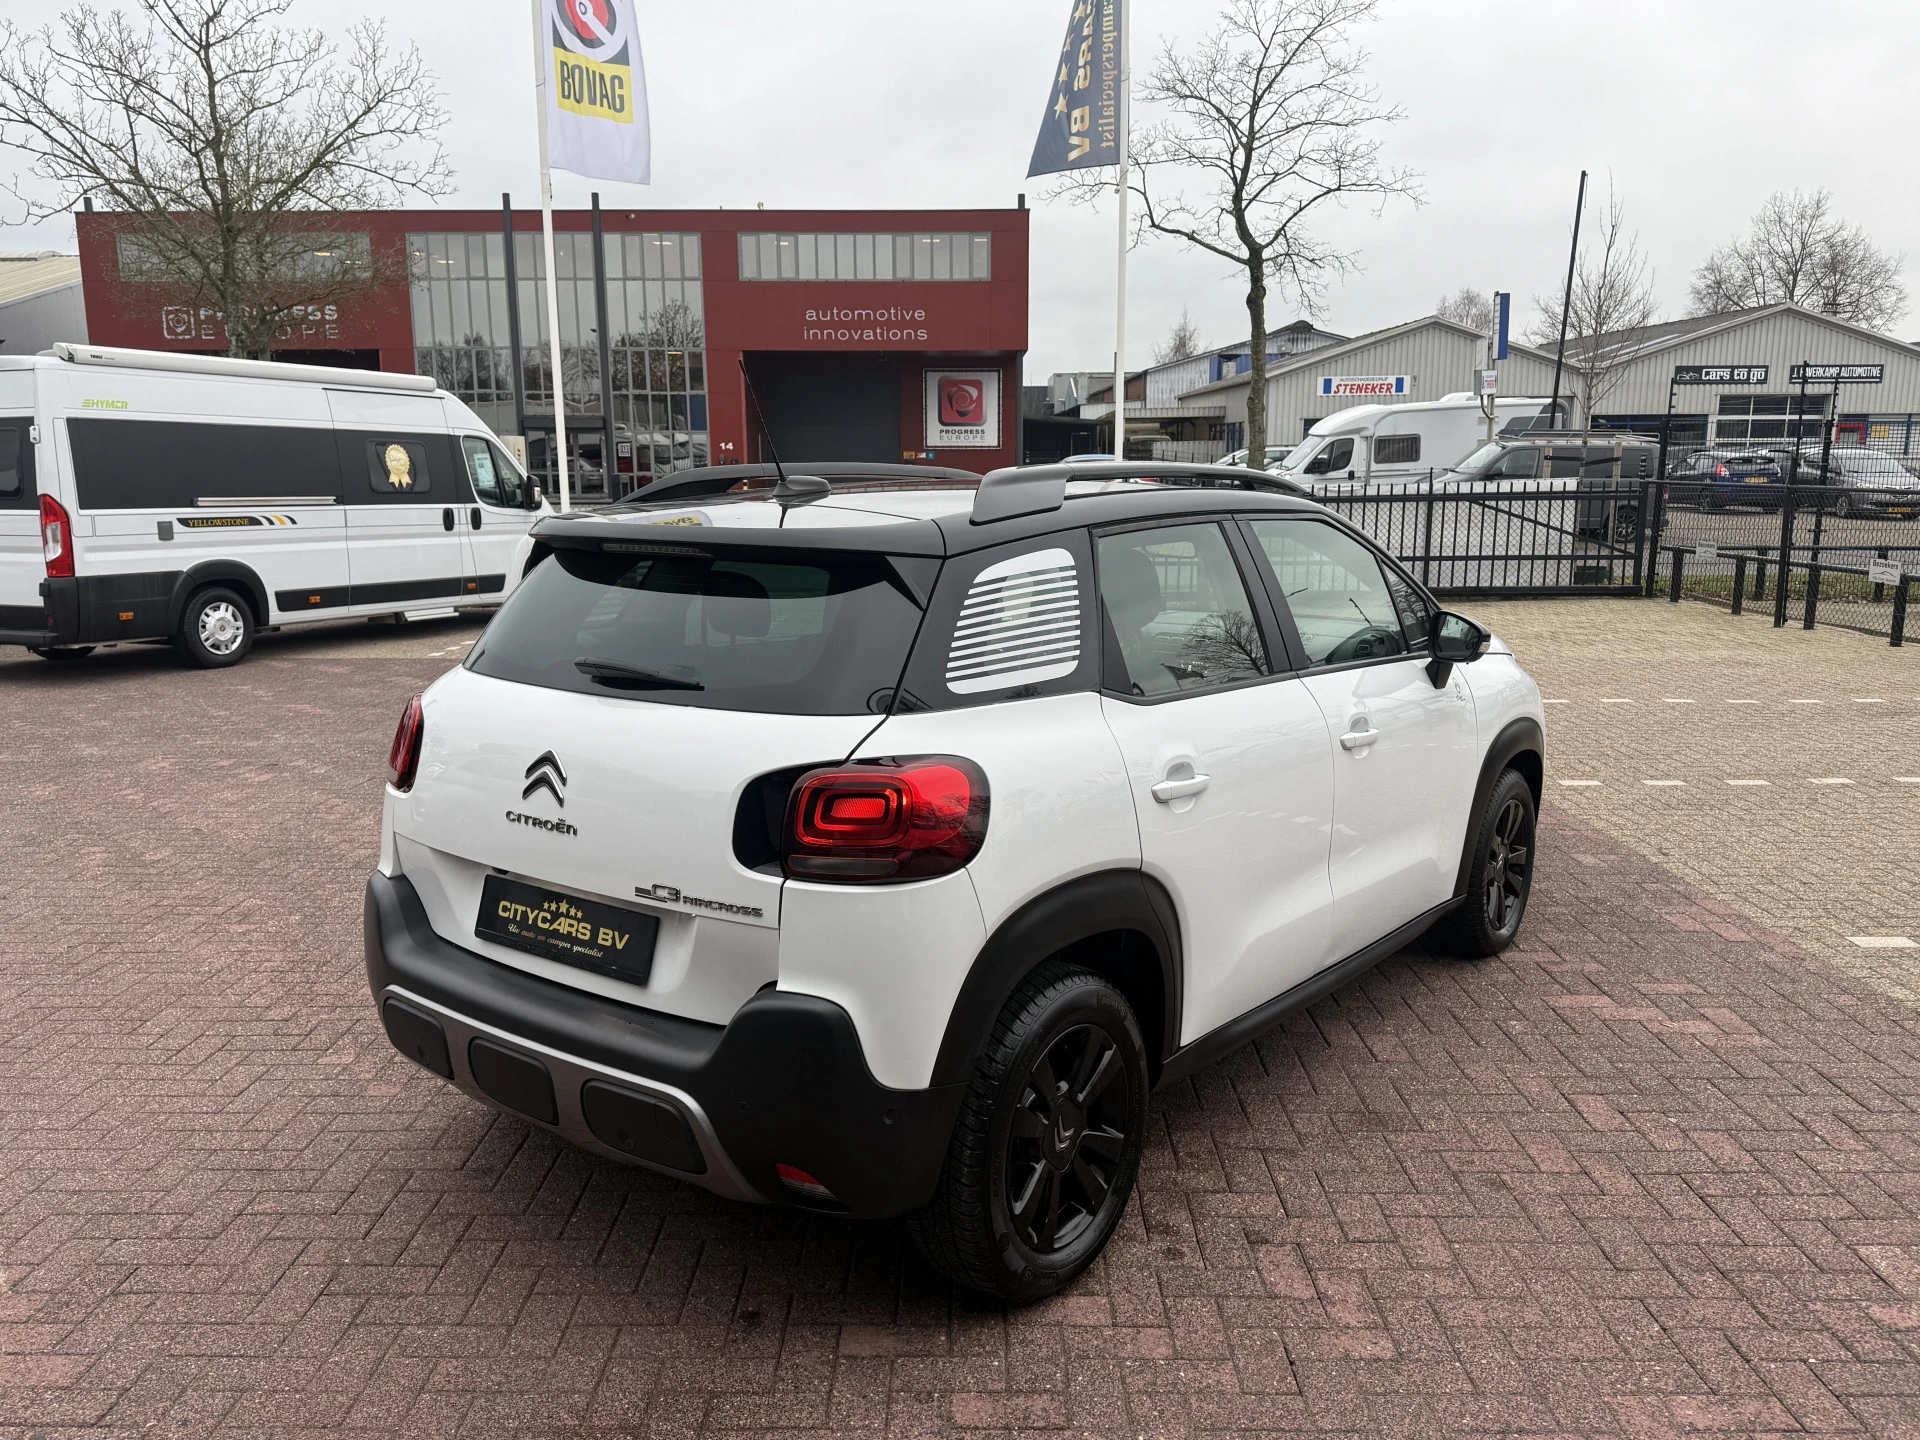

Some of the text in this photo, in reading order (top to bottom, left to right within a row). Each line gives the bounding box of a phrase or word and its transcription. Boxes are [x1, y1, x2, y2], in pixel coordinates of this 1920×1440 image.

[560, 60, 625, 113] BOVAG
[805, 306, 926, 321] automotive
[803, 326, 928, 341] innovations
[1701, 368, 1766, 383] Cars to go
[1840, 366, 1882, 377] AUTOMOTIVE
[1333, 383, 1393, 394] STENEKER
[91, 399, 128, 410] HYMER
[720, 442, 734, 450] 14
[188, 518, 249, 527] YELLOWSTONE
[505, 810, 578, 837] CITROËN
[651, 883, 763, 917] C3 AIRCROSS
[497, 900, 630, 950] CITYCARS BV
[521, 929, 536, 939] auto
[547, 936, 572, 949] camper
[572, 944, 604, 958] specialist
